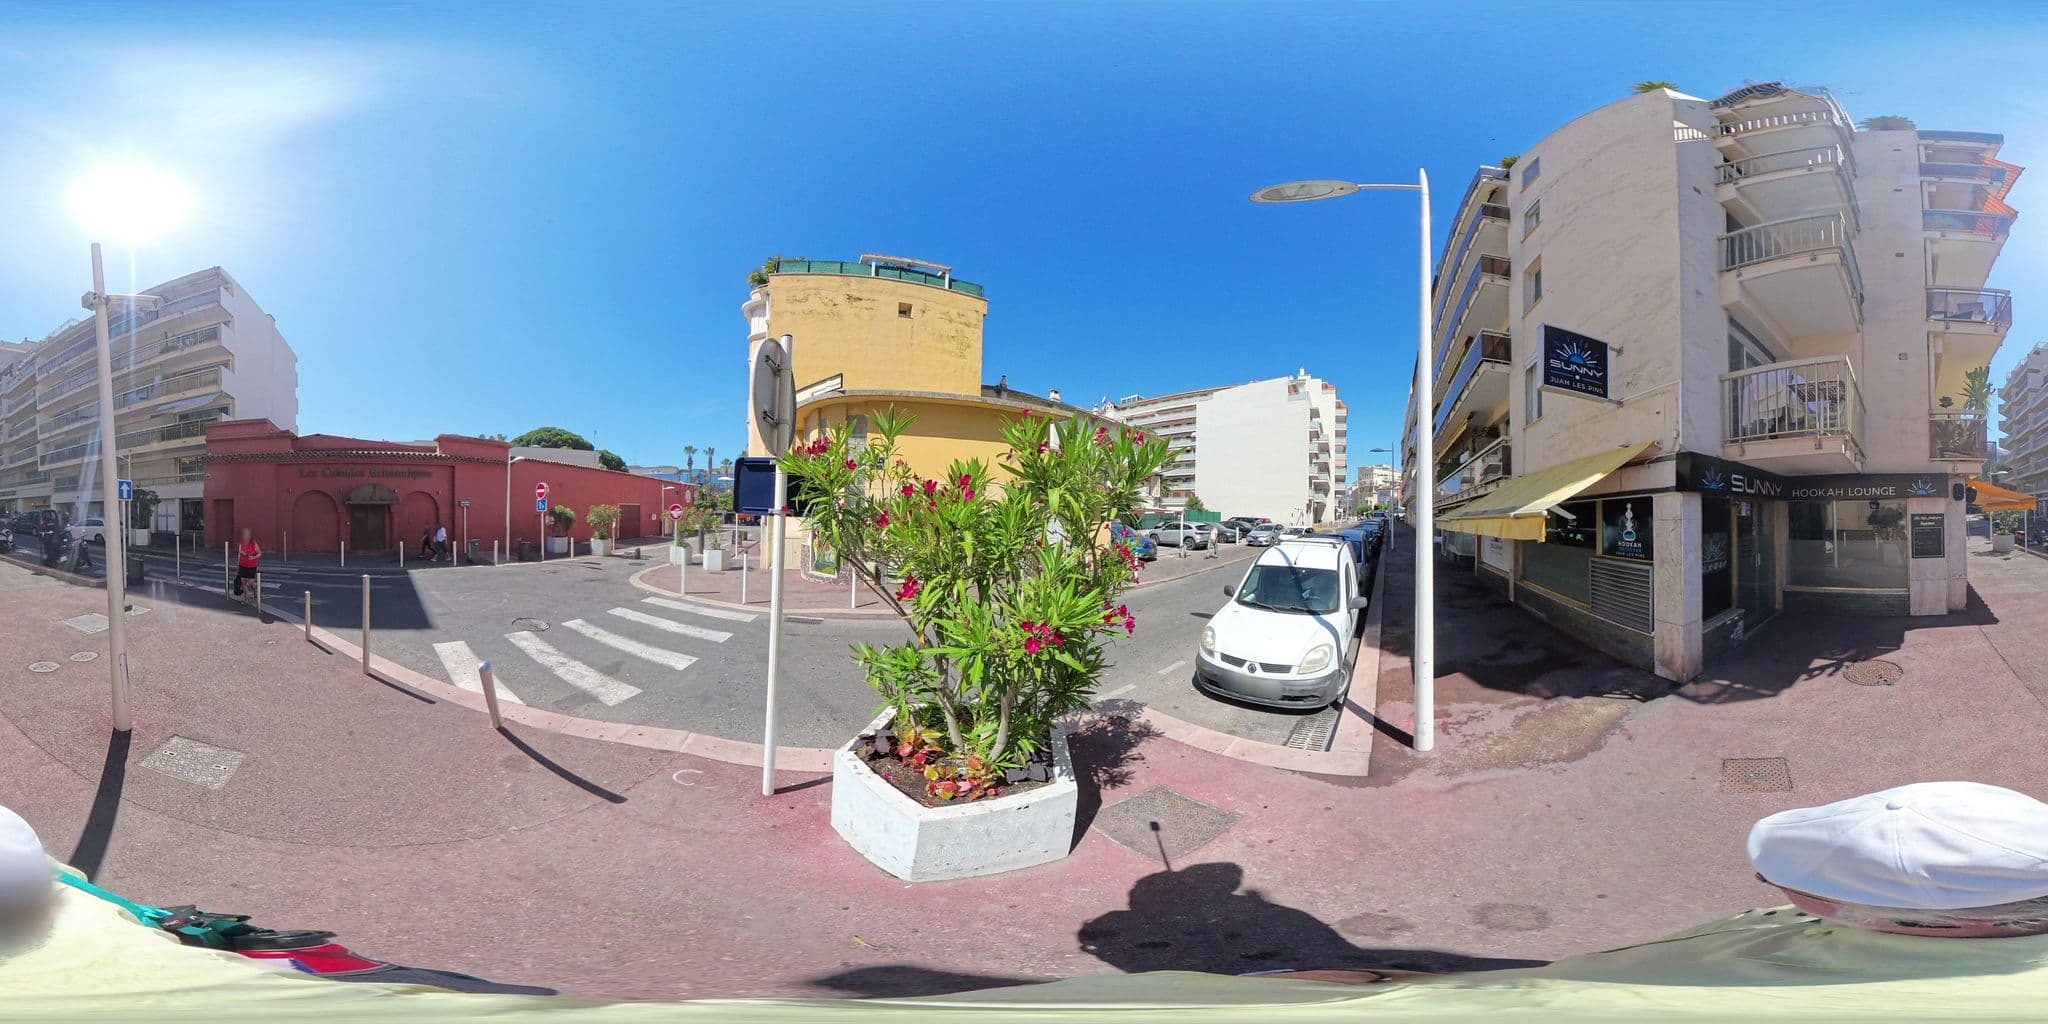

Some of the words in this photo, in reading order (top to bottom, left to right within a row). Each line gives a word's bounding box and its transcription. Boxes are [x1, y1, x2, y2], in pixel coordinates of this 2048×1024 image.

[1550, 359, 1603, 378] SUNNY
[1551, 376, 1570, 386] JUAN
[1573, 381, 1586, 390] LES
[1588, 385, 1604, 394] PINS
[1731, 474, 1783, 496] SUNNY
[1792, 488, 1844, 498] HOOKAH
[1848, 486, 1896, 496] LOUNGE
